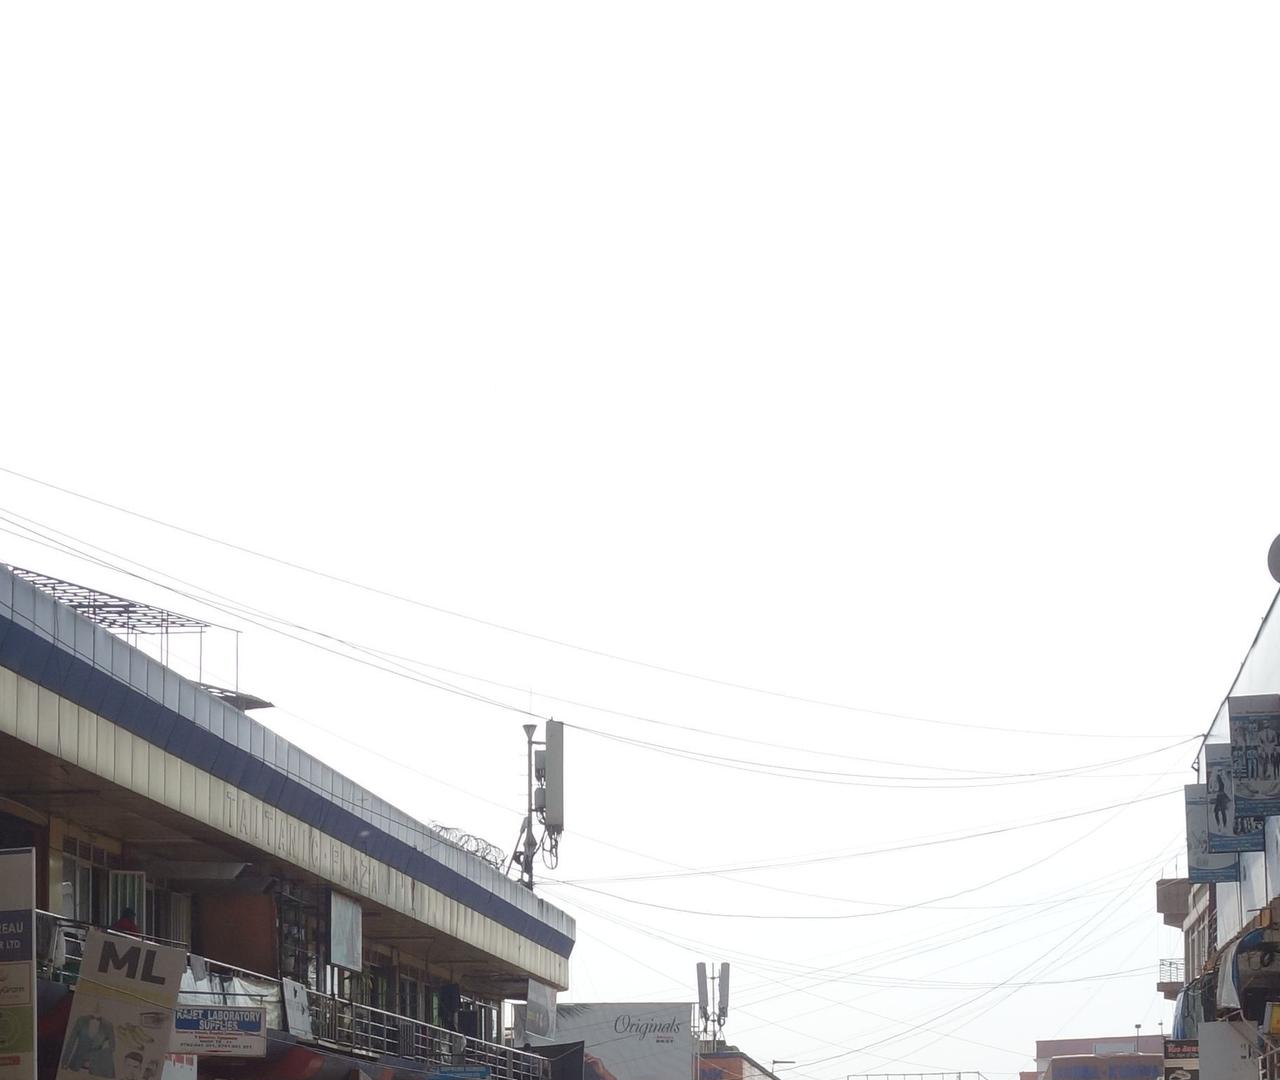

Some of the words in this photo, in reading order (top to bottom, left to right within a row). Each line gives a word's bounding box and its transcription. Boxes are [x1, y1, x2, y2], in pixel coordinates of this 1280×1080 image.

[6, 939, 21, 950] LTD
[97, 940, 166, 985] ML
[207, 1011, 261, 1022] LABORATORY
[199, 1020, 239, 1031] SUPPLIES
[613, 1014, 681, 1040] Originals
